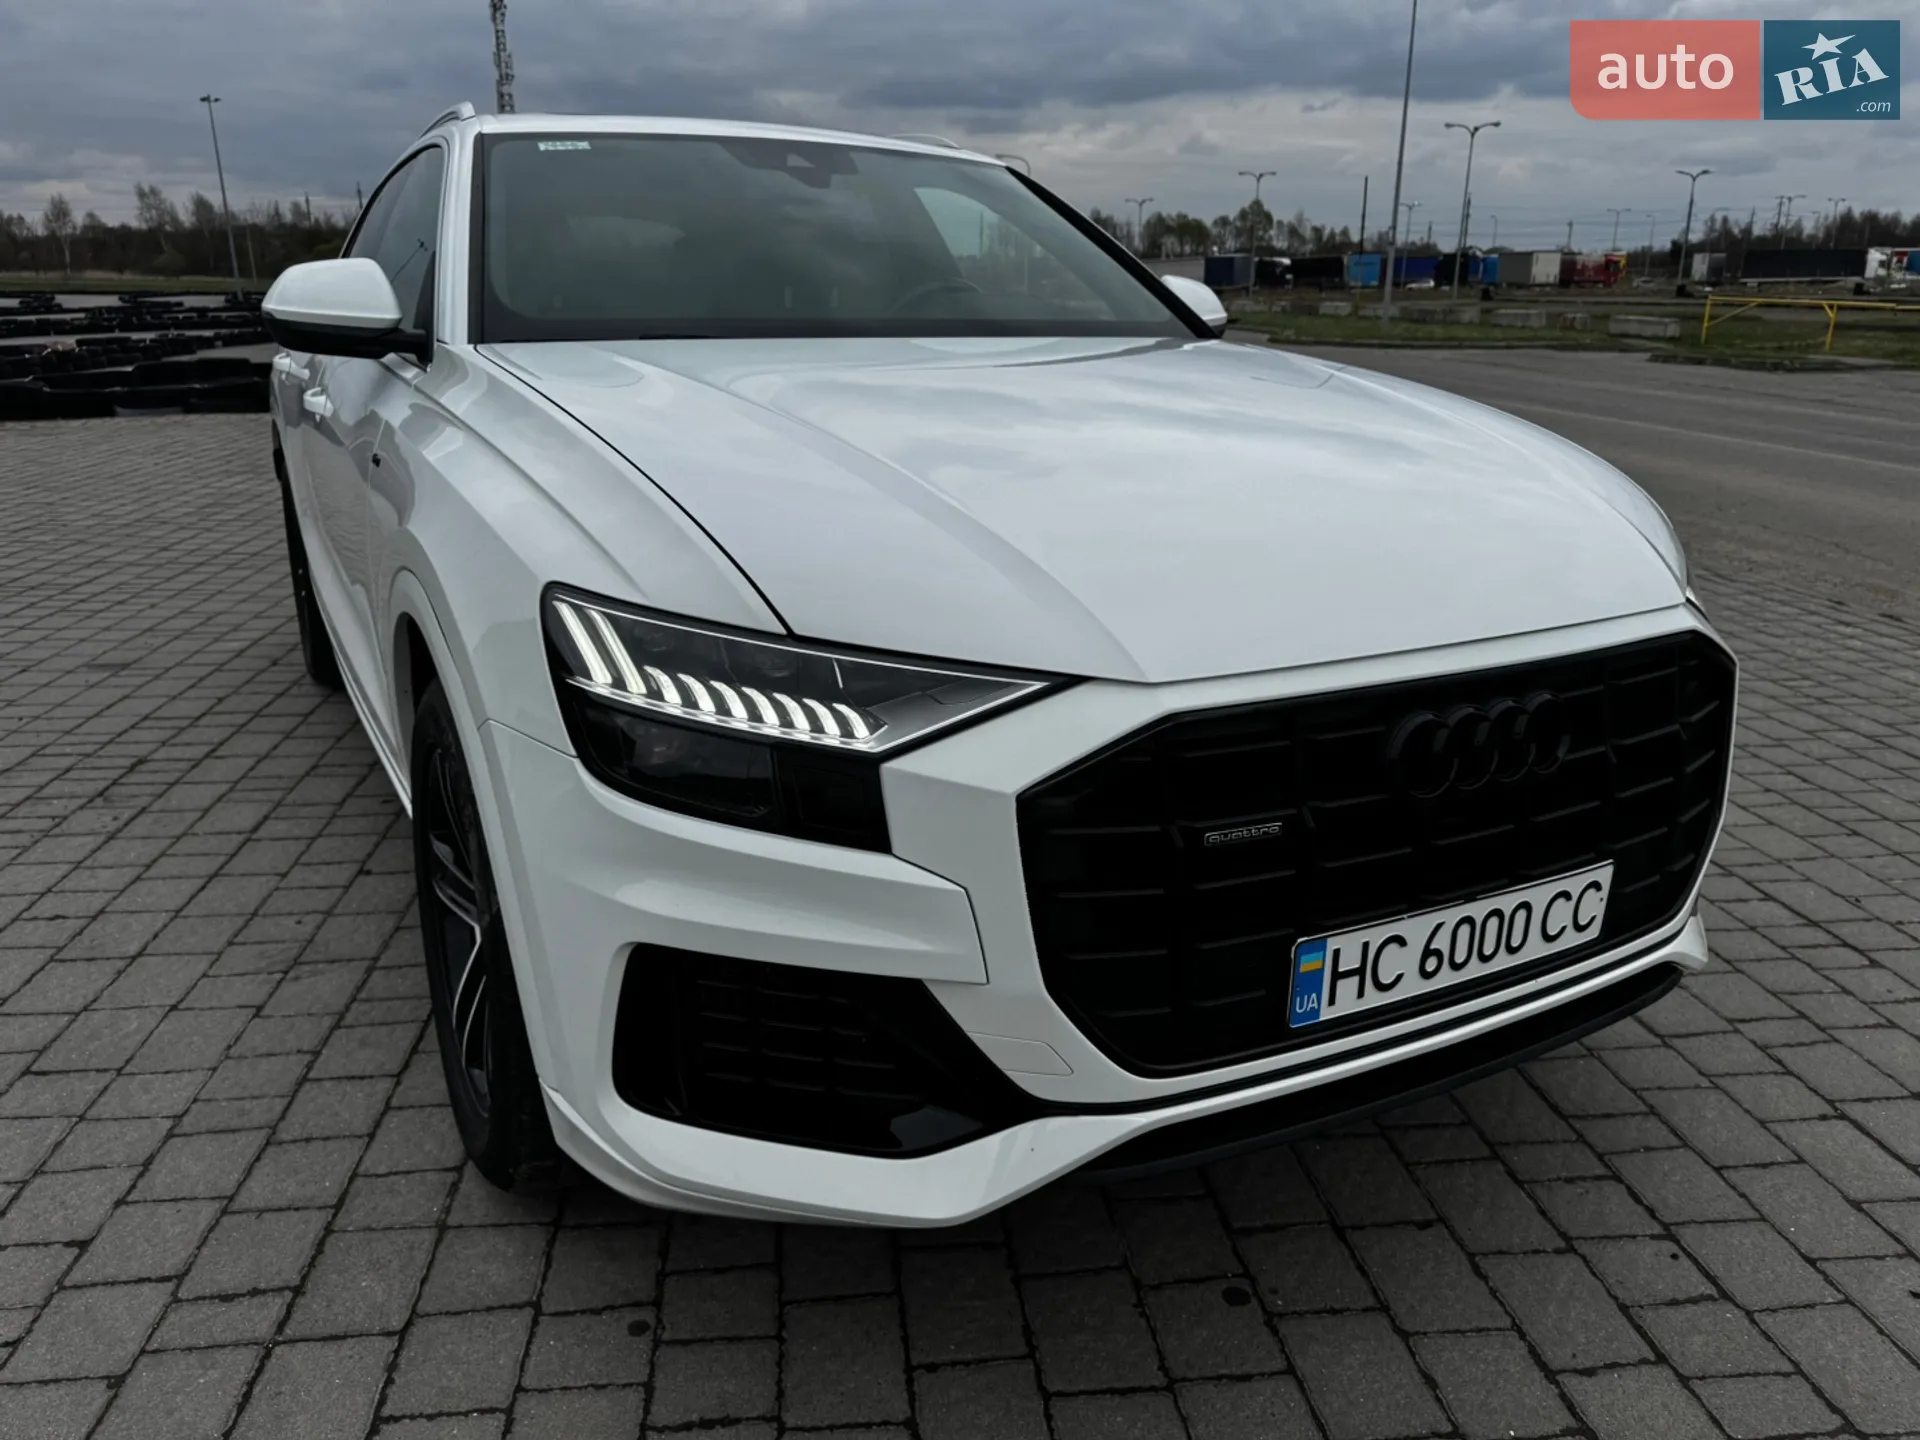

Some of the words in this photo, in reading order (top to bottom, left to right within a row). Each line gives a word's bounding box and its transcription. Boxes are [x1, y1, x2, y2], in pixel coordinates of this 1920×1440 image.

[1209, 826, 1280, 844] quattro
[1327, 933, 1408, 1008] HC
[1418, 899, 1533, 980] 6000
[1540, 879, 1603, 944] CC
[1295, 991, 1319, 1014] UA
